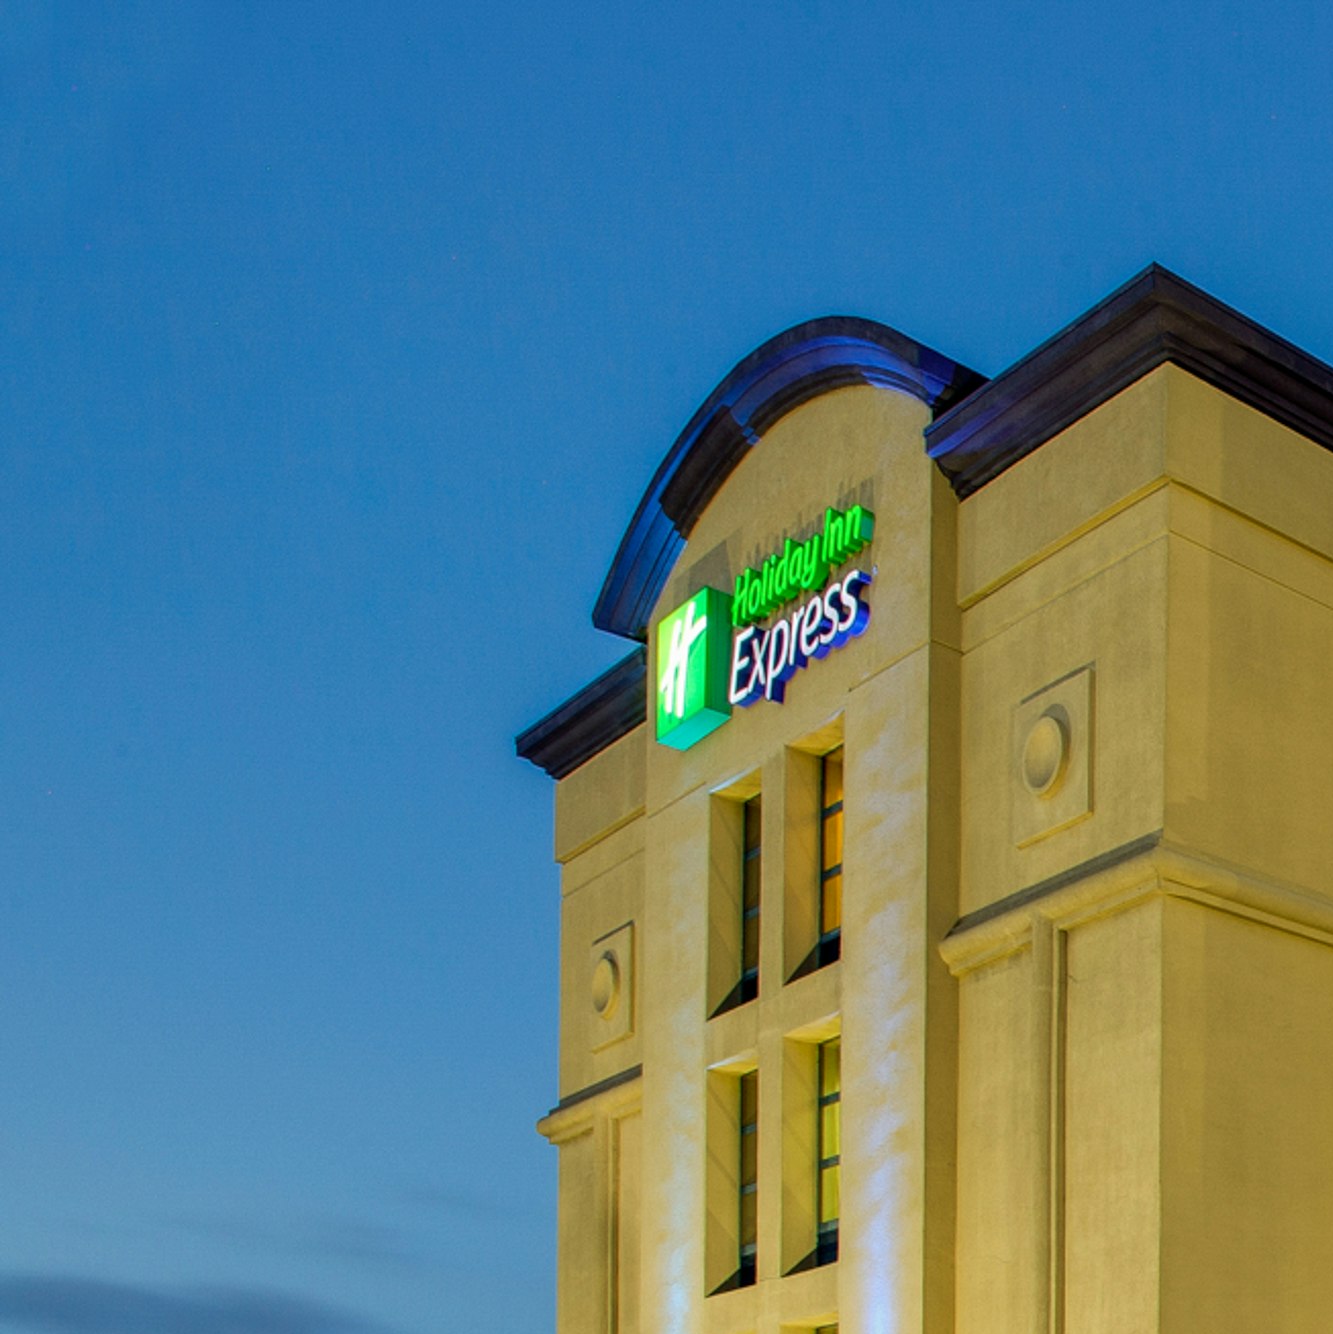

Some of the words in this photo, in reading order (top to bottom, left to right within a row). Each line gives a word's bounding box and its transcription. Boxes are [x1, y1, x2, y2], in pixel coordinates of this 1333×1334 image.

[732, 534, 828, 626] Holiday
[821, 505, 871, 563] Inn
[729, 569, 872, 706] Express
